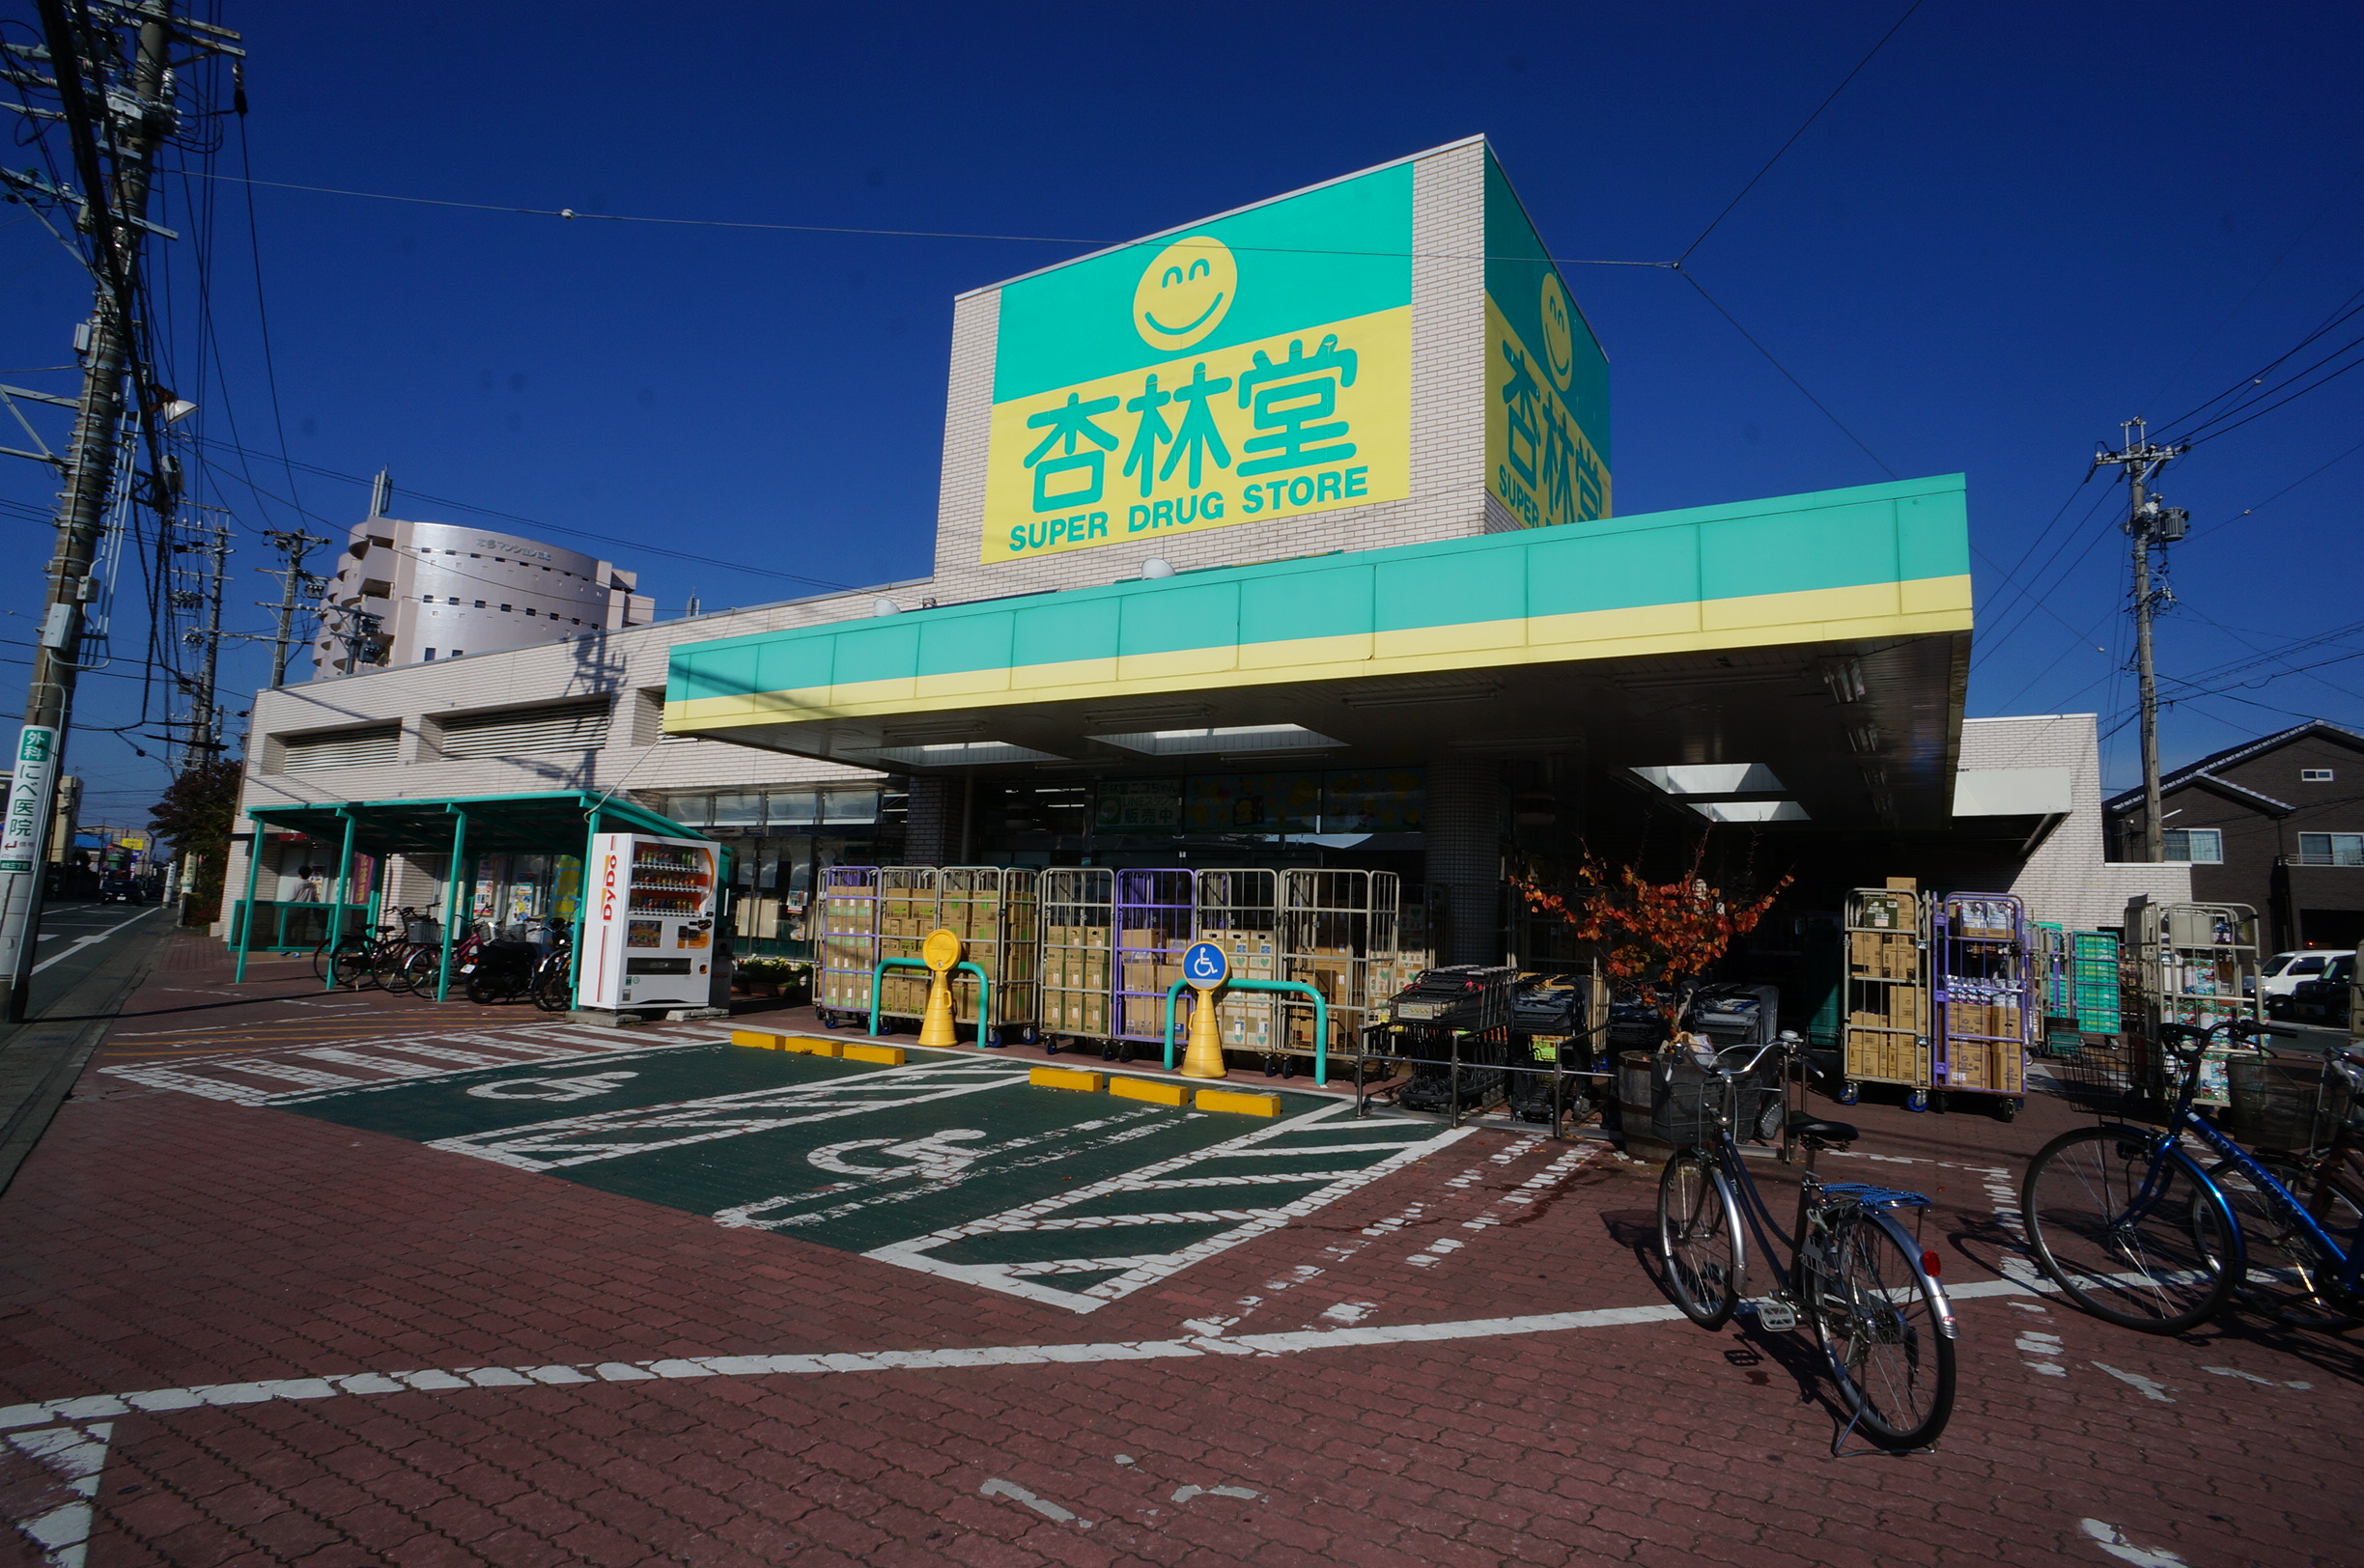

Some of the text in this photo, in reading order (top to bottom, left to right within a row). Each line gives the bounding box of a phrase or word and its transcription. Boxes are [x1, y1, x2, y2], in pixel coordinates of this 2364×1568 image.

[1023, 333, 1358, 514] 杏林堂
[1008, 465, 1369, 552] SUPER DRUG STORE
[1499, 463, 1540, 528] SUPER
[23, 731, 45, 760] 外科
[10, 764, 42, 838] にべ医院
[1124, 808, 1173, 826] 販売中
